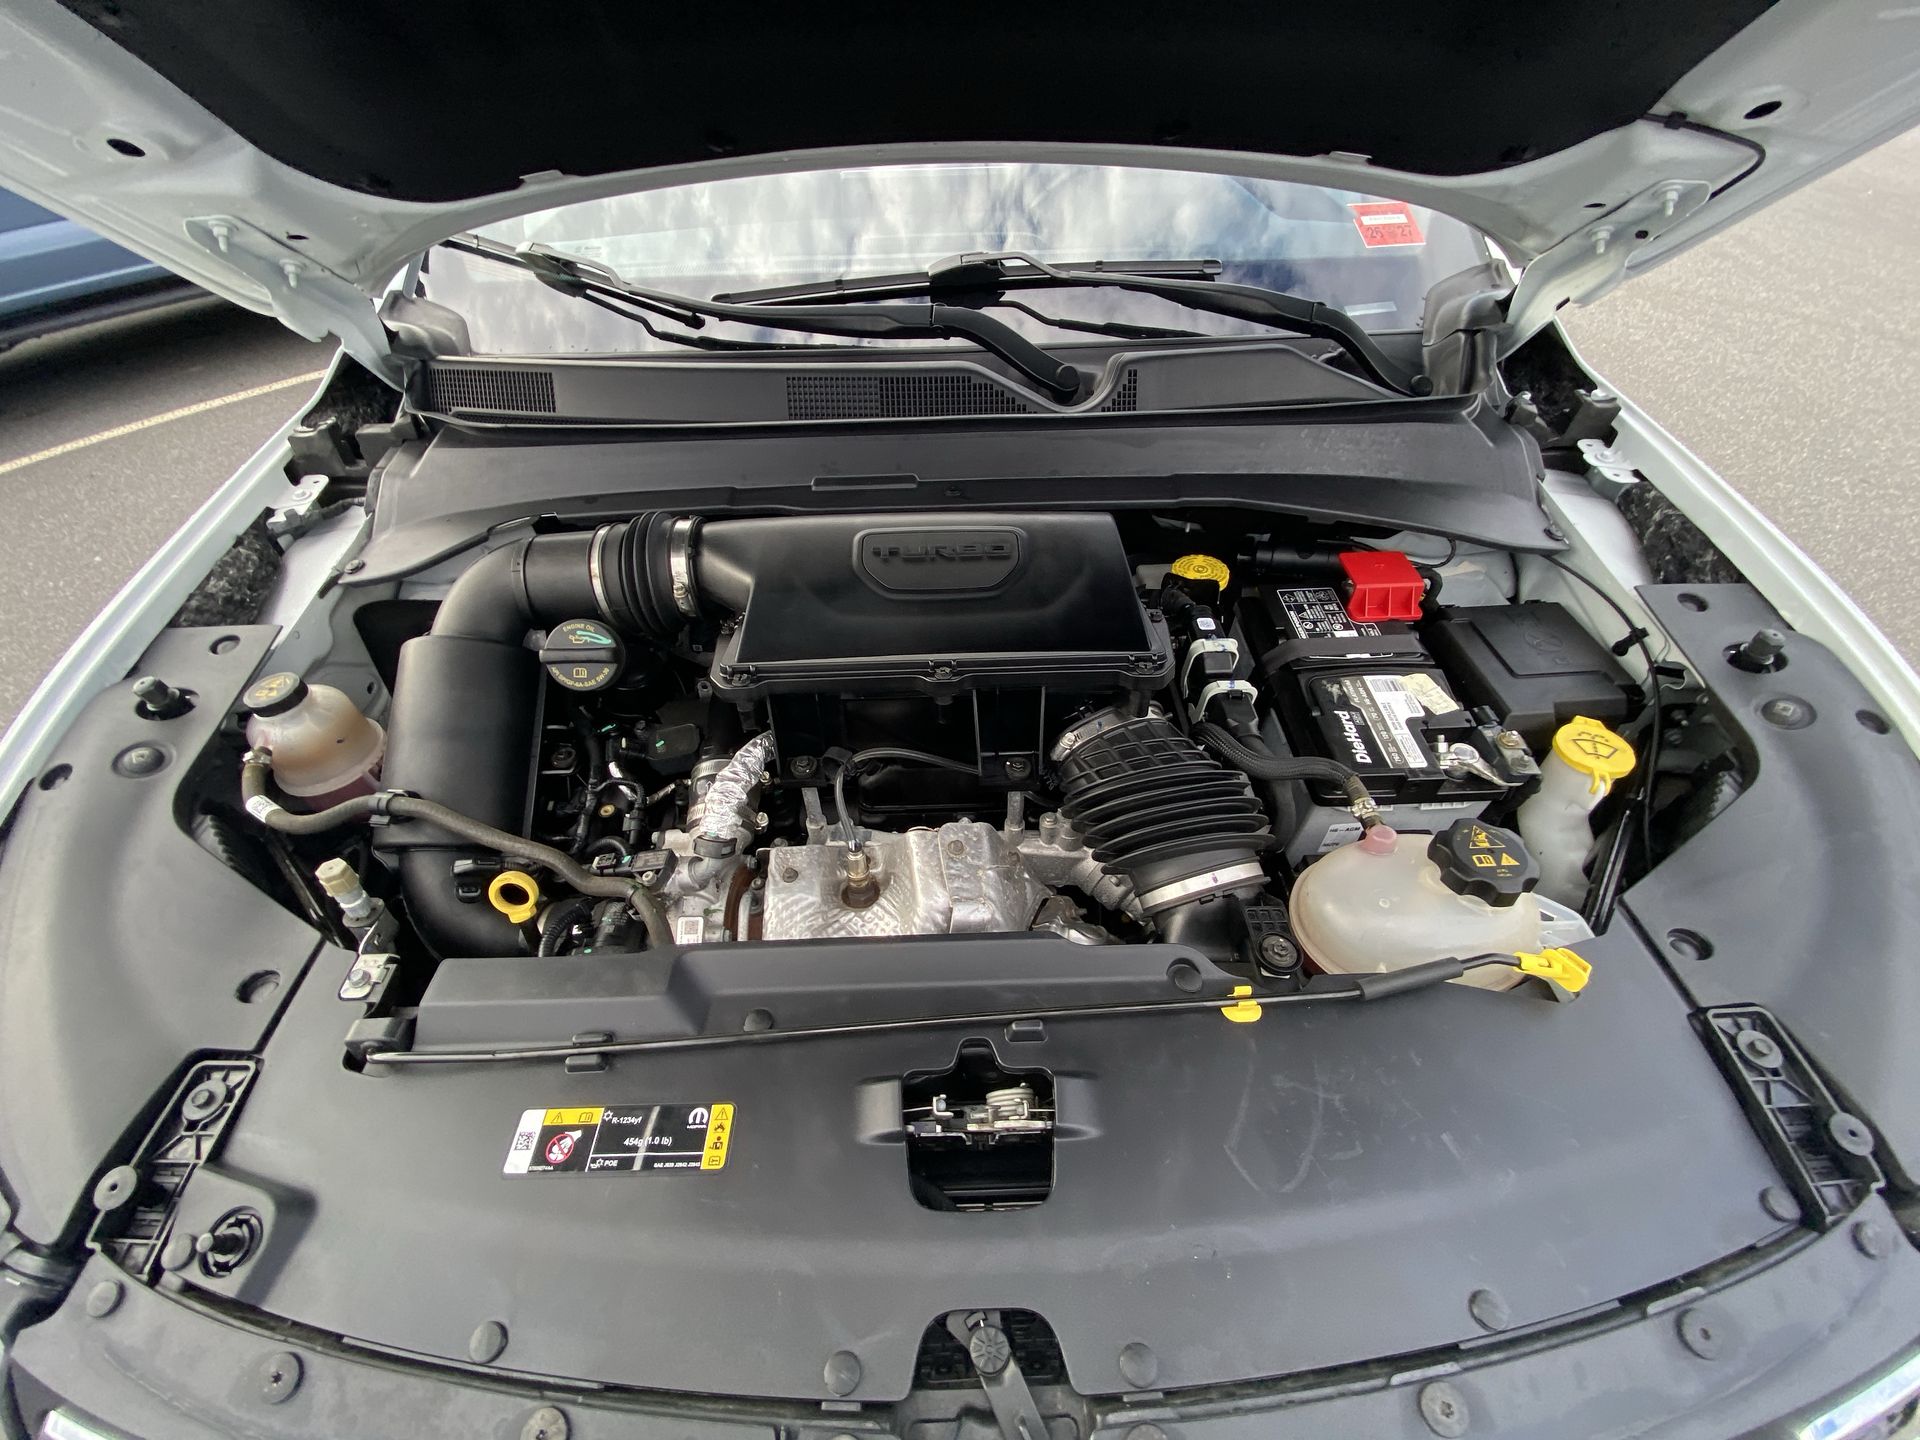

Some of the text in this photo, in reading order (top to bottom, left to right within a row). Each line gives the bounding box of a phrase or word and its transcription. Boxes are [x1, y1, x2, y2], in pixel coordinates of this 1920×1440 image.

[872, 544, 1012, 563] TURBO
[1344, 679, 1361, 704] PLATINUM
[1333, 710, 1372, 764] DieHard
[611, 1115, 643, 1126] R-1234yf
[623, 1135, 673, 1148] 454g (1.0 lb)
[603, 1158, 618, 1168] POE
